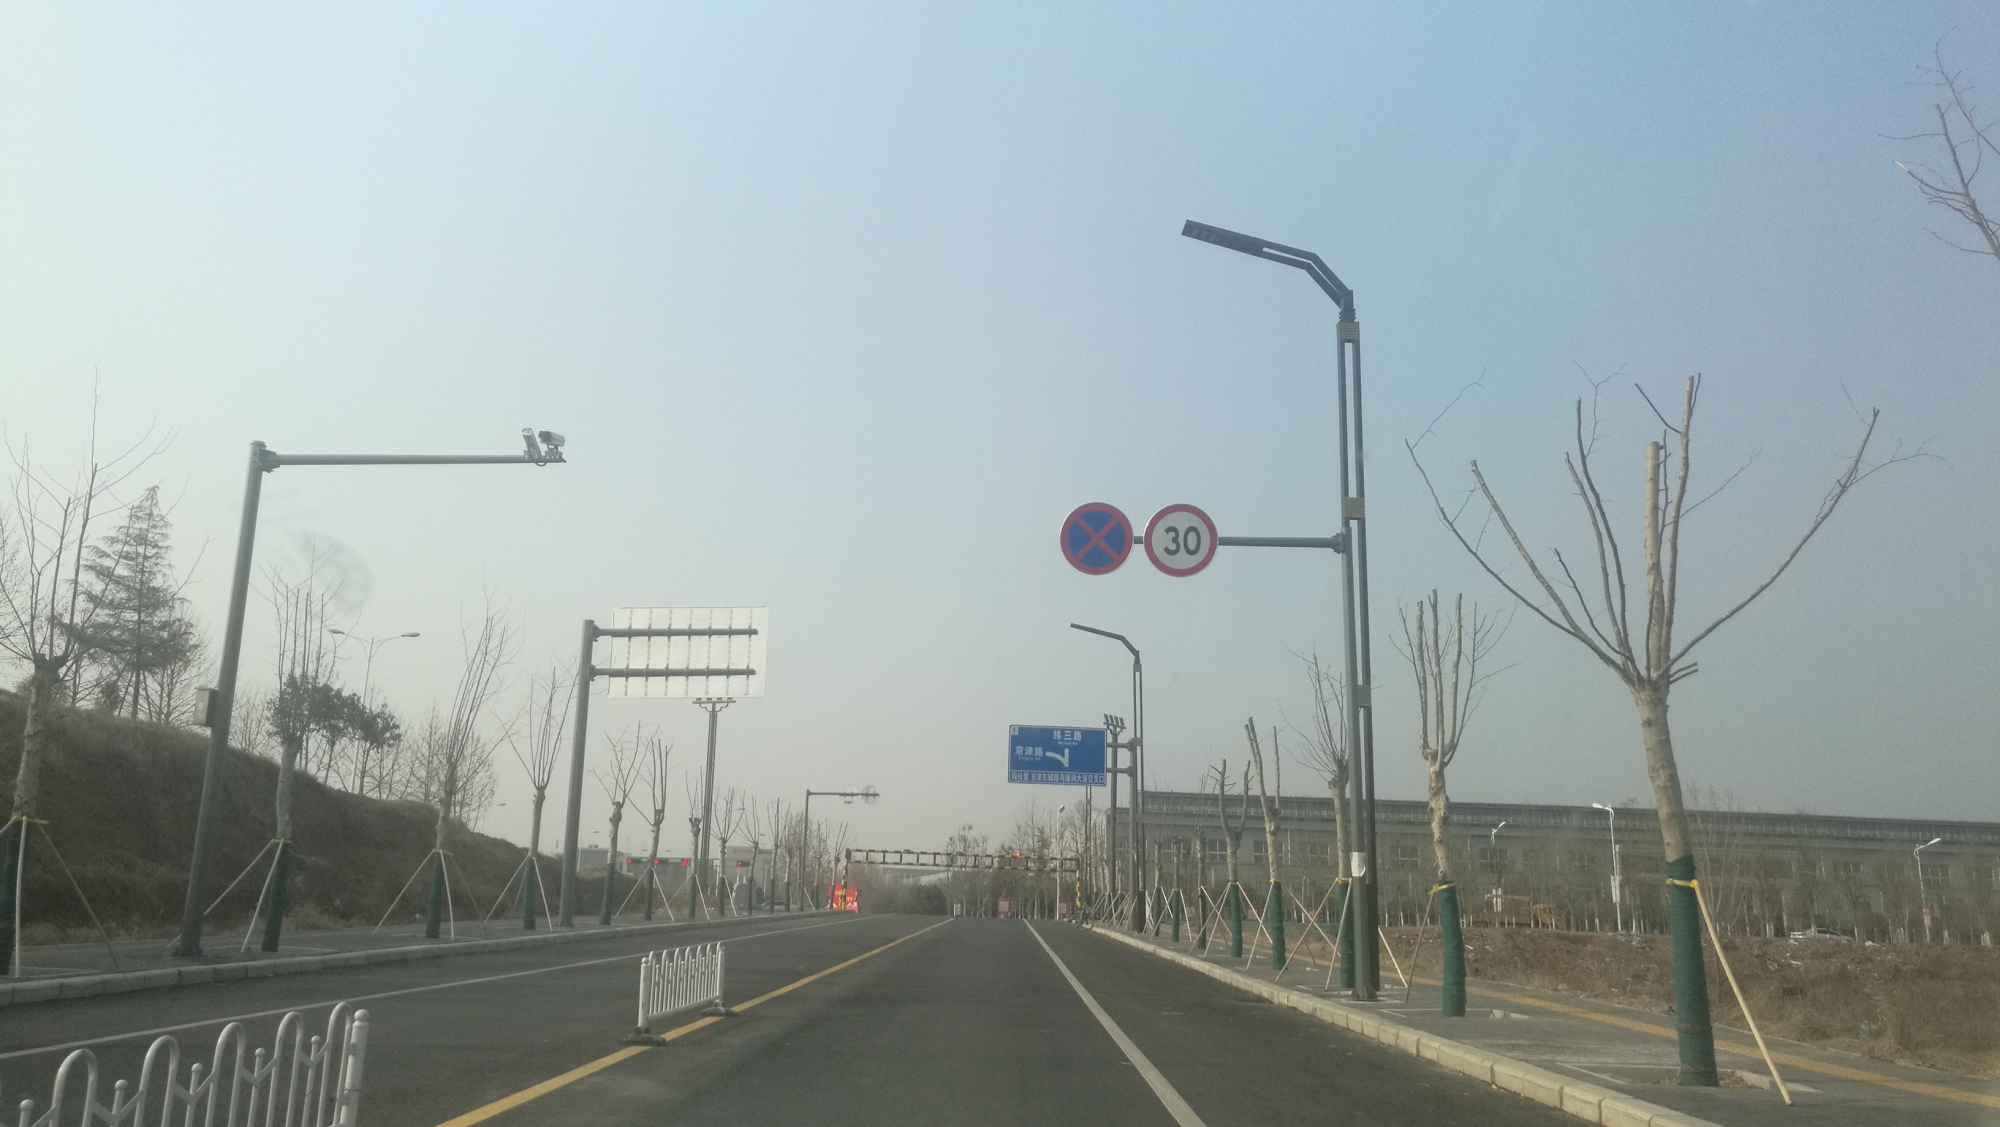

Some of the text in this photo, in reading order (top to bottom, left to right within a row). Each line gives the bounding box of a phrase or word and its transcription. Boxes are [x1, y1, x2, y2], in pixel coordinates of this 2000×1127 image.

[1163, 525, 1202, 556] 30
[1053, 730, 1082, 742] 纬三路
[1015, 745, 1044, 757] 京津路
